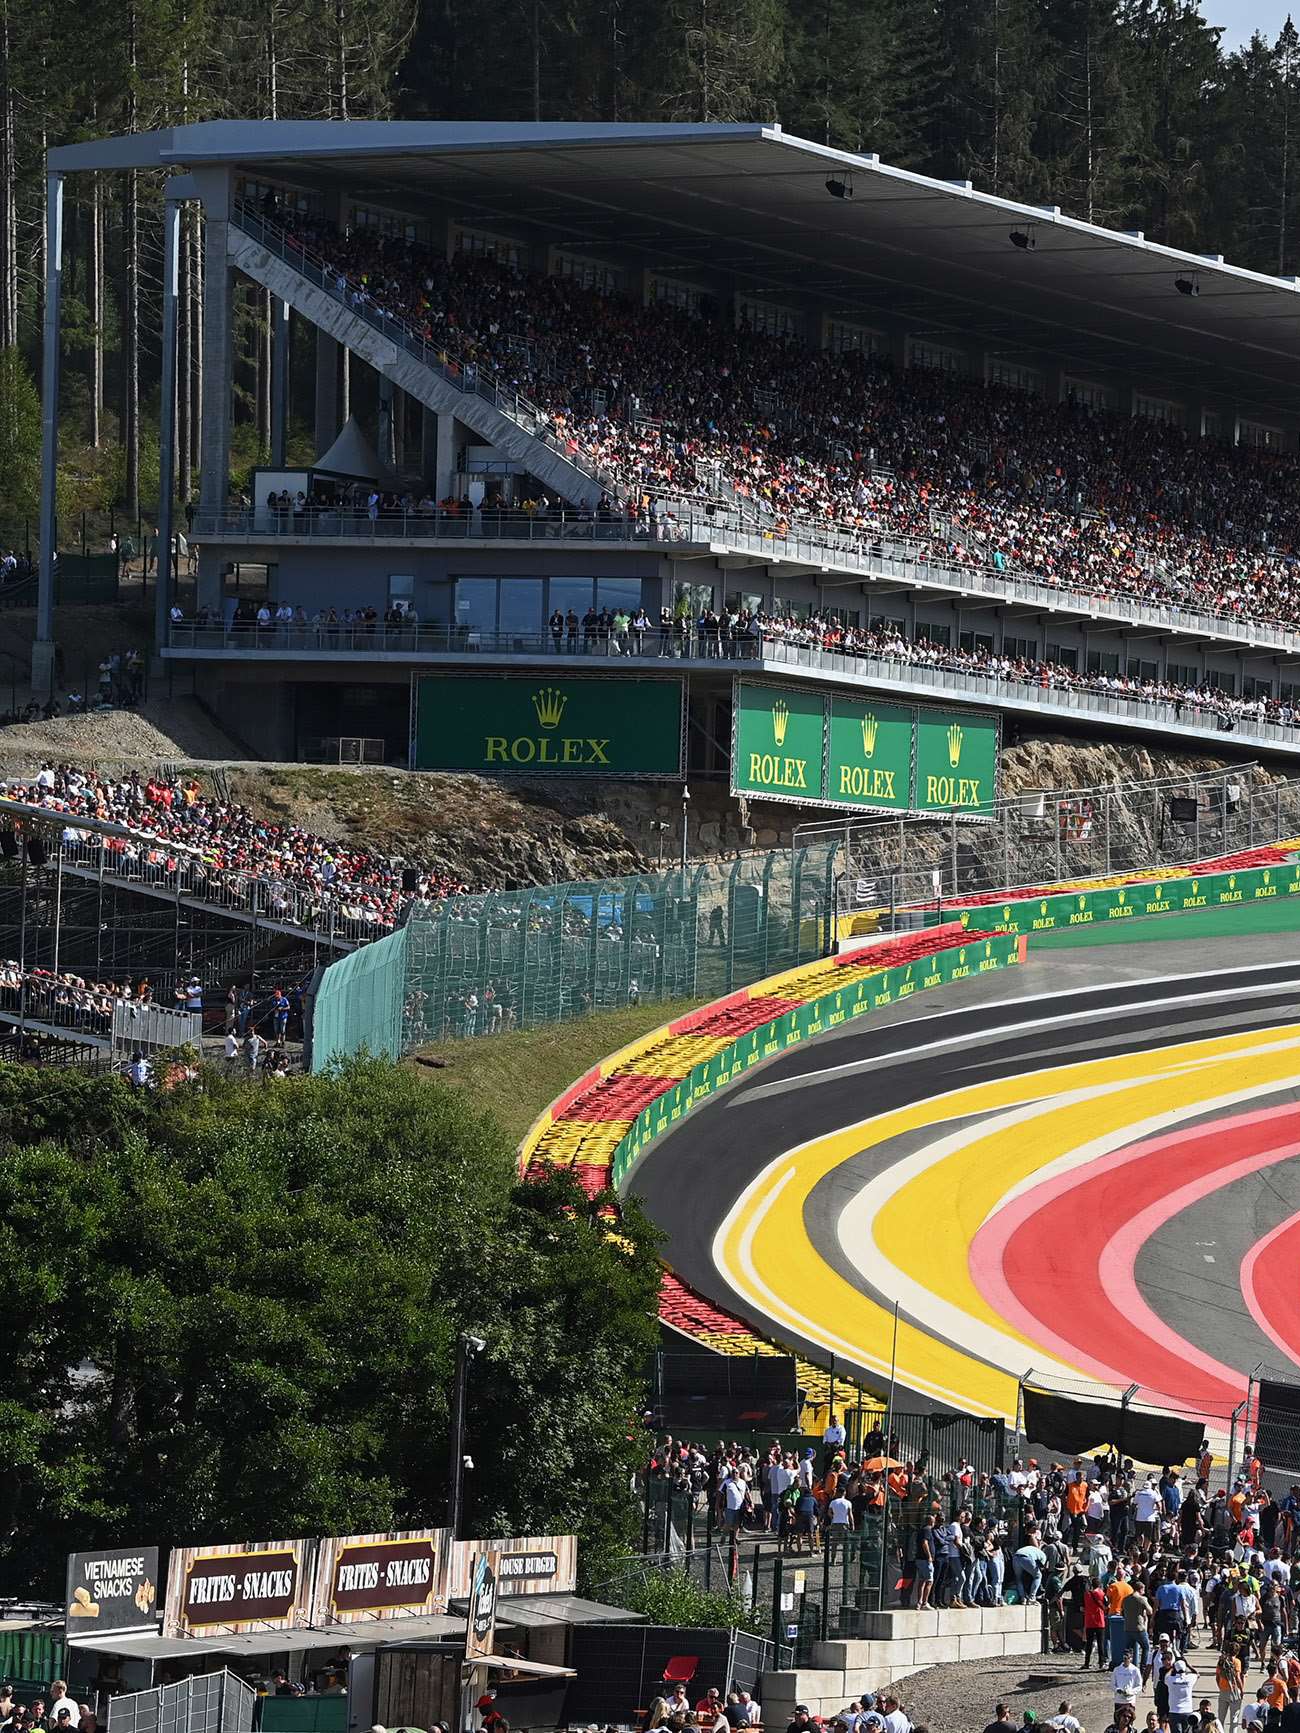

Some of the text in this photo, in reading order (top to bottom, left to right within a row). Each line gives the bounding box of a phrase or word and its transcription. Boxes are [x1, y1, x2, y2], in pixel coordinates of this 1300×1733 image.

[484, 737, 611, 763] ROLEX
[749, 753, 807, 788] ROLEX
[839, 765, 896, 798] ROLEX
[926, 775, 980, 806] ROLEX
[1146, 900, 1170, 912] ROLEX
[1183, 896, 1206, 908] ROLEX
[1220, 890, 1242, 902] ROLEX
[1070, 911, 1093, 924] ROLEX
[1109, 905, 1133, 918] ROLEX
[1033, 917, 1055, 929] ROLEX
[84, 1557, 144, 1580] VIETNAMESE
[337, 1562, 379, 1591] FRITES
[386, 1558, 431, 1587] SNACKS
[525, 1557, 556, 1574] BURGER
[93, 1577, 133, 1599] SNACKS
[189, 1574, 236, 1604] FRITES
[242, 1570, 292, 1600] SNACKS
